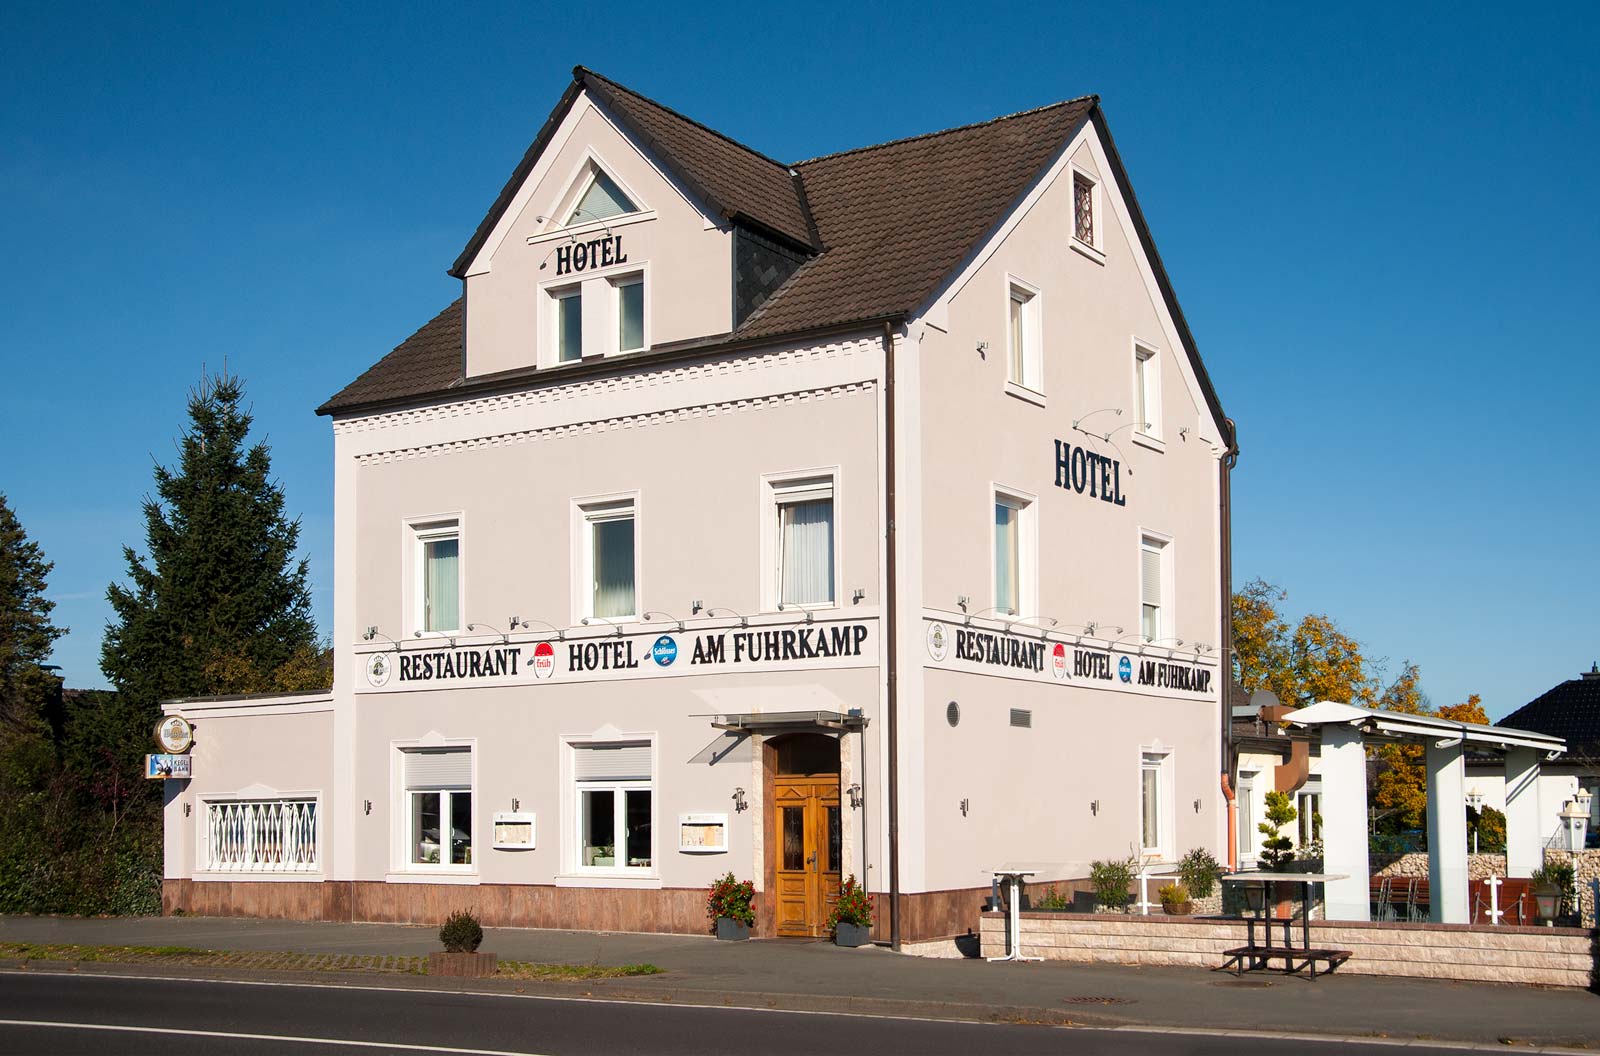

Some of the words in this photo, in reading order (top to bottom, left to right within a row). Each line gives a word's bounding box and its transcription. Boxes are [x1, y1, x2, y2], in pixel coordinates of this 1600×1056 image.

[556, 235, 627, 276] HOTEL
[1054, 438, 1125, 507] HOTEL
[399, 648, 521, 681] RESTAURANT
[568, 640, 638, 672] HOTEL
[690, 634, 725, 665] AM
[733, 625, 868, 663] FUHRKAMP
[955, 629, 1046, 673] RESTAURANT
[1073, 649, 1113, 681] HOTEL
[1137, 660, 1157, 686] AM
[1157, 662, 1211, 694] FUHRKAMP
